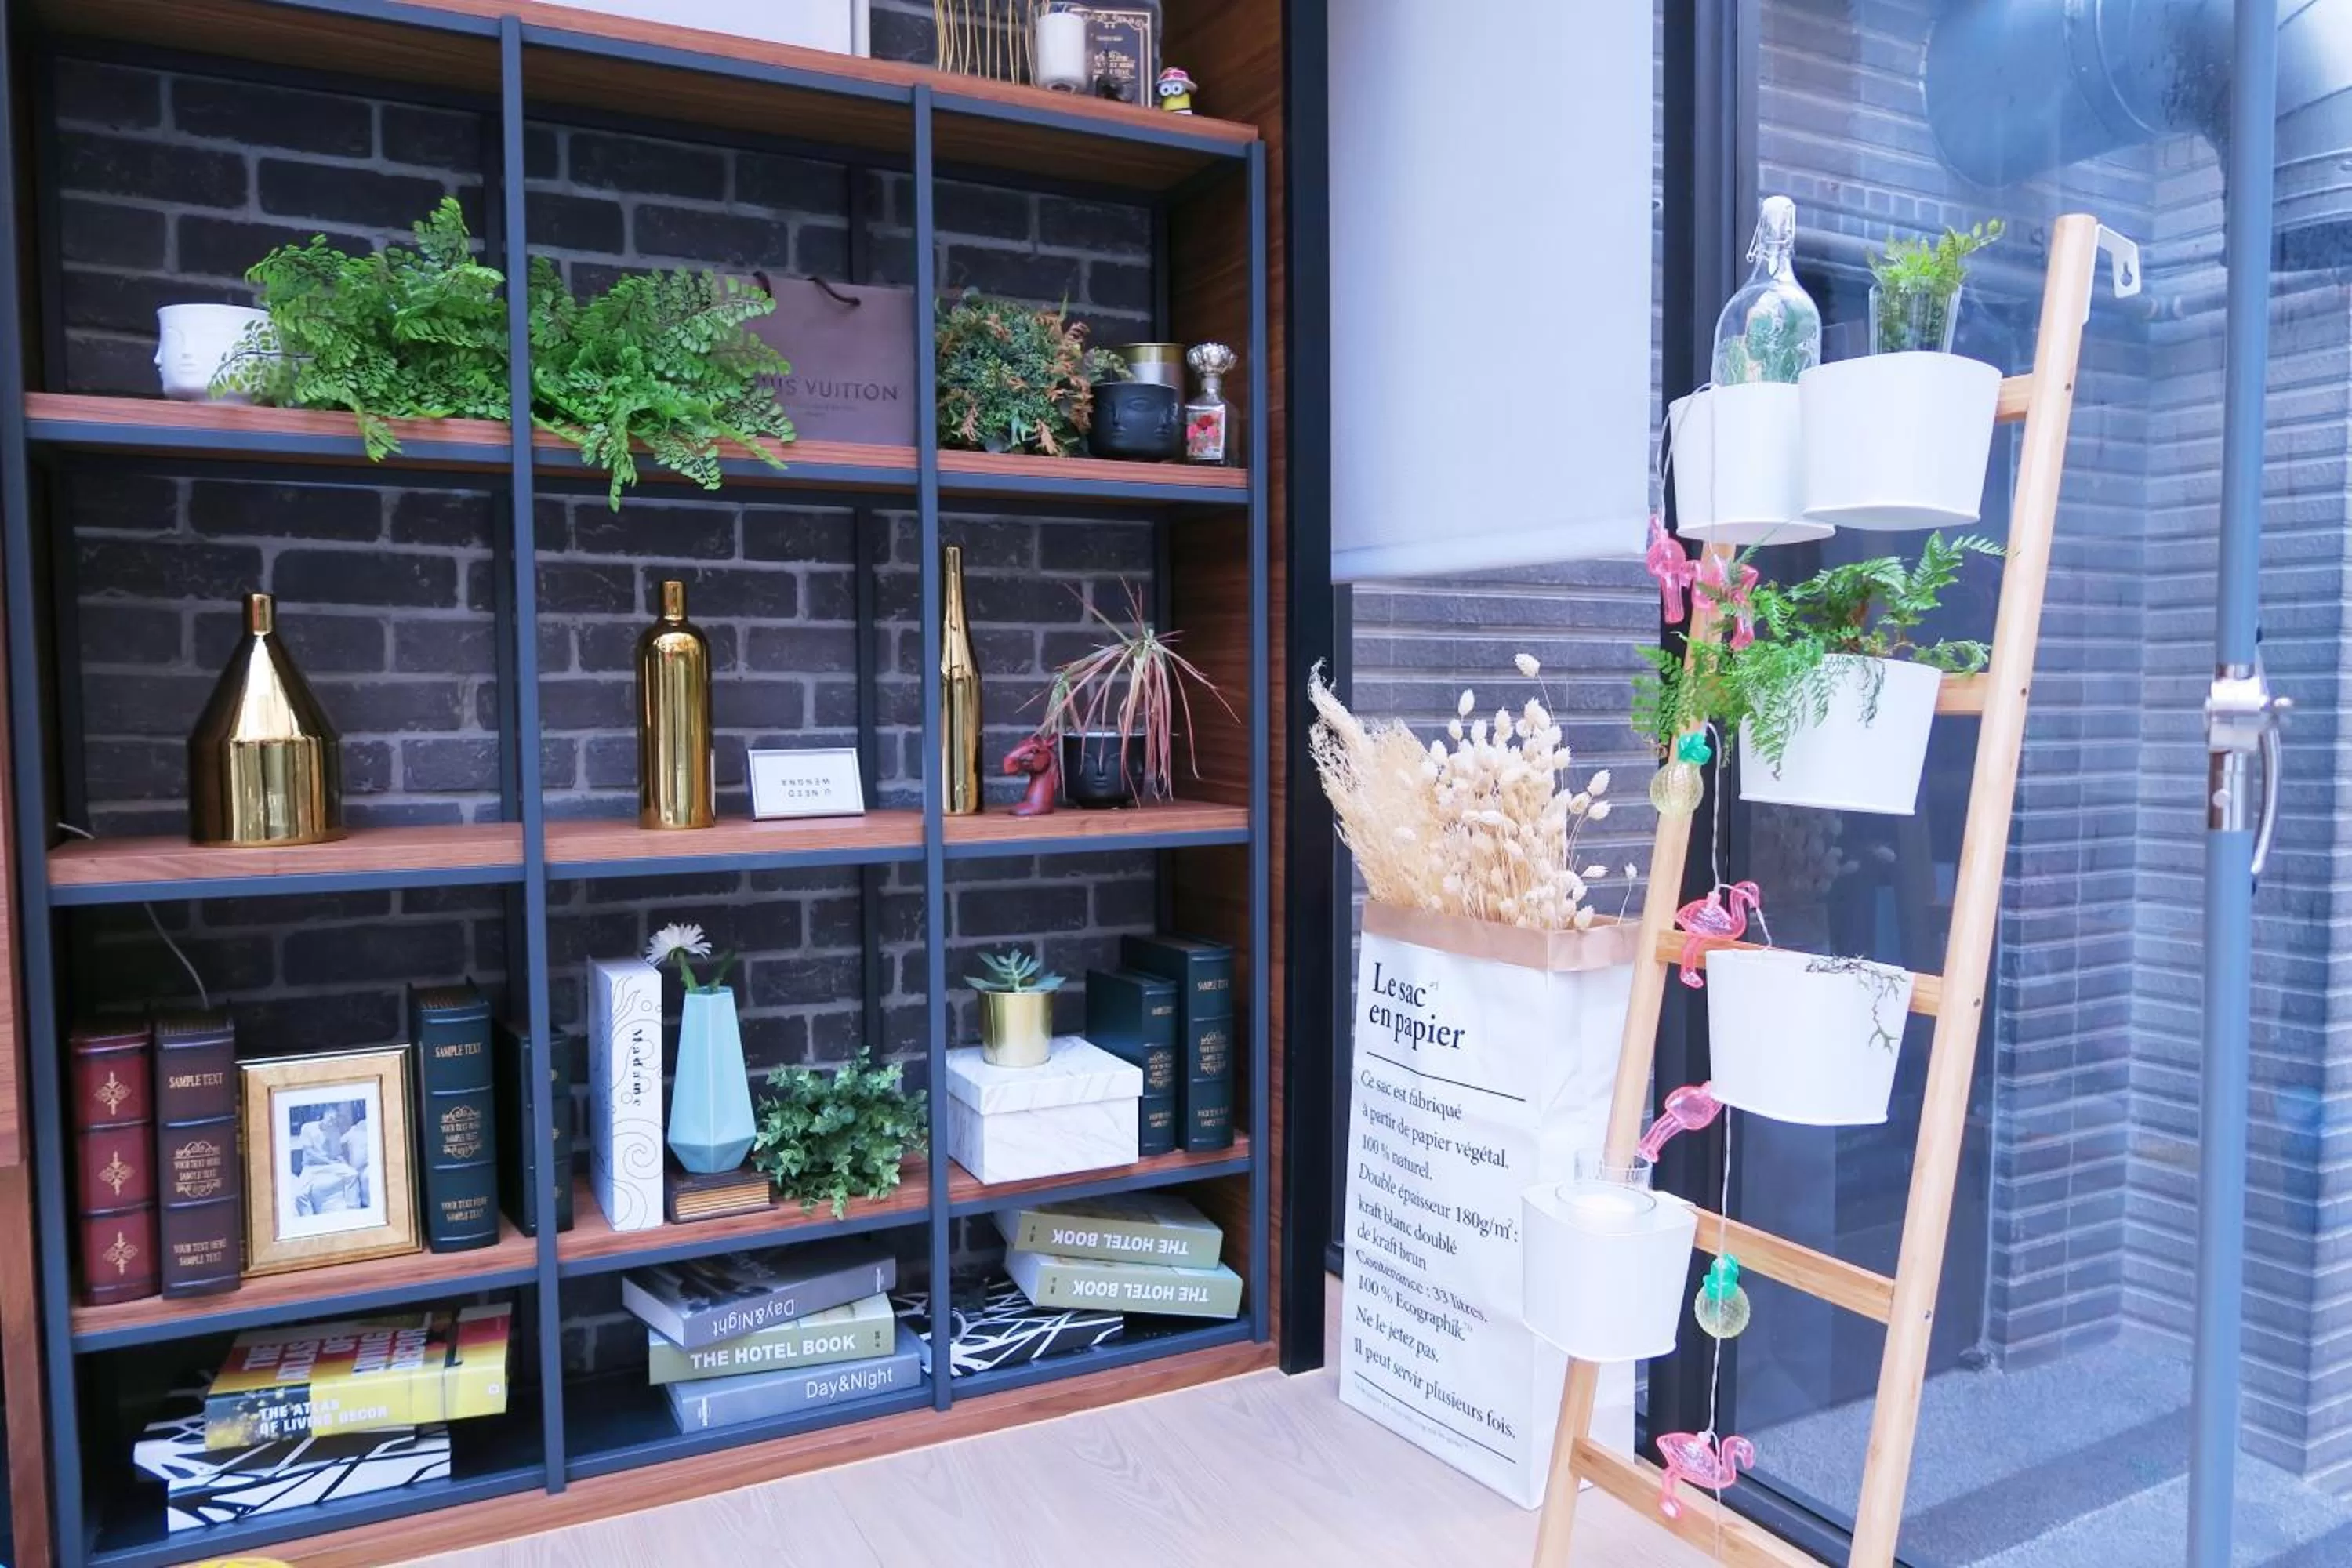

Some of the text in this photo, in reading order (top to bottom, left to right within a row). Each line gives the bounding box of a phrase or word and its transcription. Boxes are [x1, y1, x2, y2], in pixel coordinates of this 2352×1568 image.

[805, 379, 898, 401] VUITTON
[1372, 962, 1426, 1007] Le sac
[1369, 1004, 1465, 1051] en papier
[435, 1042, 481, 1058] SAMPLE TEXT
[169, 1073, 223, 1089] SAMPLE TEXT
[1361, 1069, 1462, 1121] Ce sac est fabriqué
[1363, 1103, 1509, 1169] à partir de papier végétal.
[1363, 1134, 1379, 1154] 100
[1392, 1152, 1433, 1180] naturel.
[1359, 1163, 1396, 1194] Double
[1398, 1184, 1451, 1219] épaisseur
[1051, 1229, 1098, 1247] BOOK
[1103, 1234, 1154, 1252] HOTEL
[1359, 1194, 1457, 1255] kraft blanc doublé
[1156, 1239, 1189, 1256] THE
[1357, 1221, 1427, 1271] de kraft brun
[1073, 1279, 1119, 1297] BOOK
[1123, 1282, 1174, 1301] HOTEL
[1178, 1286, 1209, 1303] THE
[1356, 1249, 1423, 1294] Contenance
[1432, 1287, 1449, 1304] 33
[1450, 1292, 1489, 1323] litres.
[1359, 1275, 1379, 1296] 100
[1381, 1285, 1393, 1303] %
[713, 1298, 794, 1337] Day&Night
[1356, 1305, 1439, 1363] Ne le jetez pas.
[242, 1345, 283, 1370] THE
[276, 1339, 320, 1380] ATLAS
[351, 1332, 391, 1377] LIVING
[390, 1328, 428, 1370] DECOR
[691, 1350, 729, 1370] THE
[735, 1341, 797, 1364] HOTEL
[802, 1334, 856, 1355] BOOK
[805, 1367, 894, 1399] Day&Night
[1365, 1346, 1391, 1370] peut
[1393, 1362, 1424, 1390] servir
[1425, 1380, 1484, 1422] plusieurs
[1487, 1410, 1515, 1439] fois.
[259, 1399, 339, 1421] THE ATLAS
[259, 1406, 387, 1438] OF LIVING DECOR
